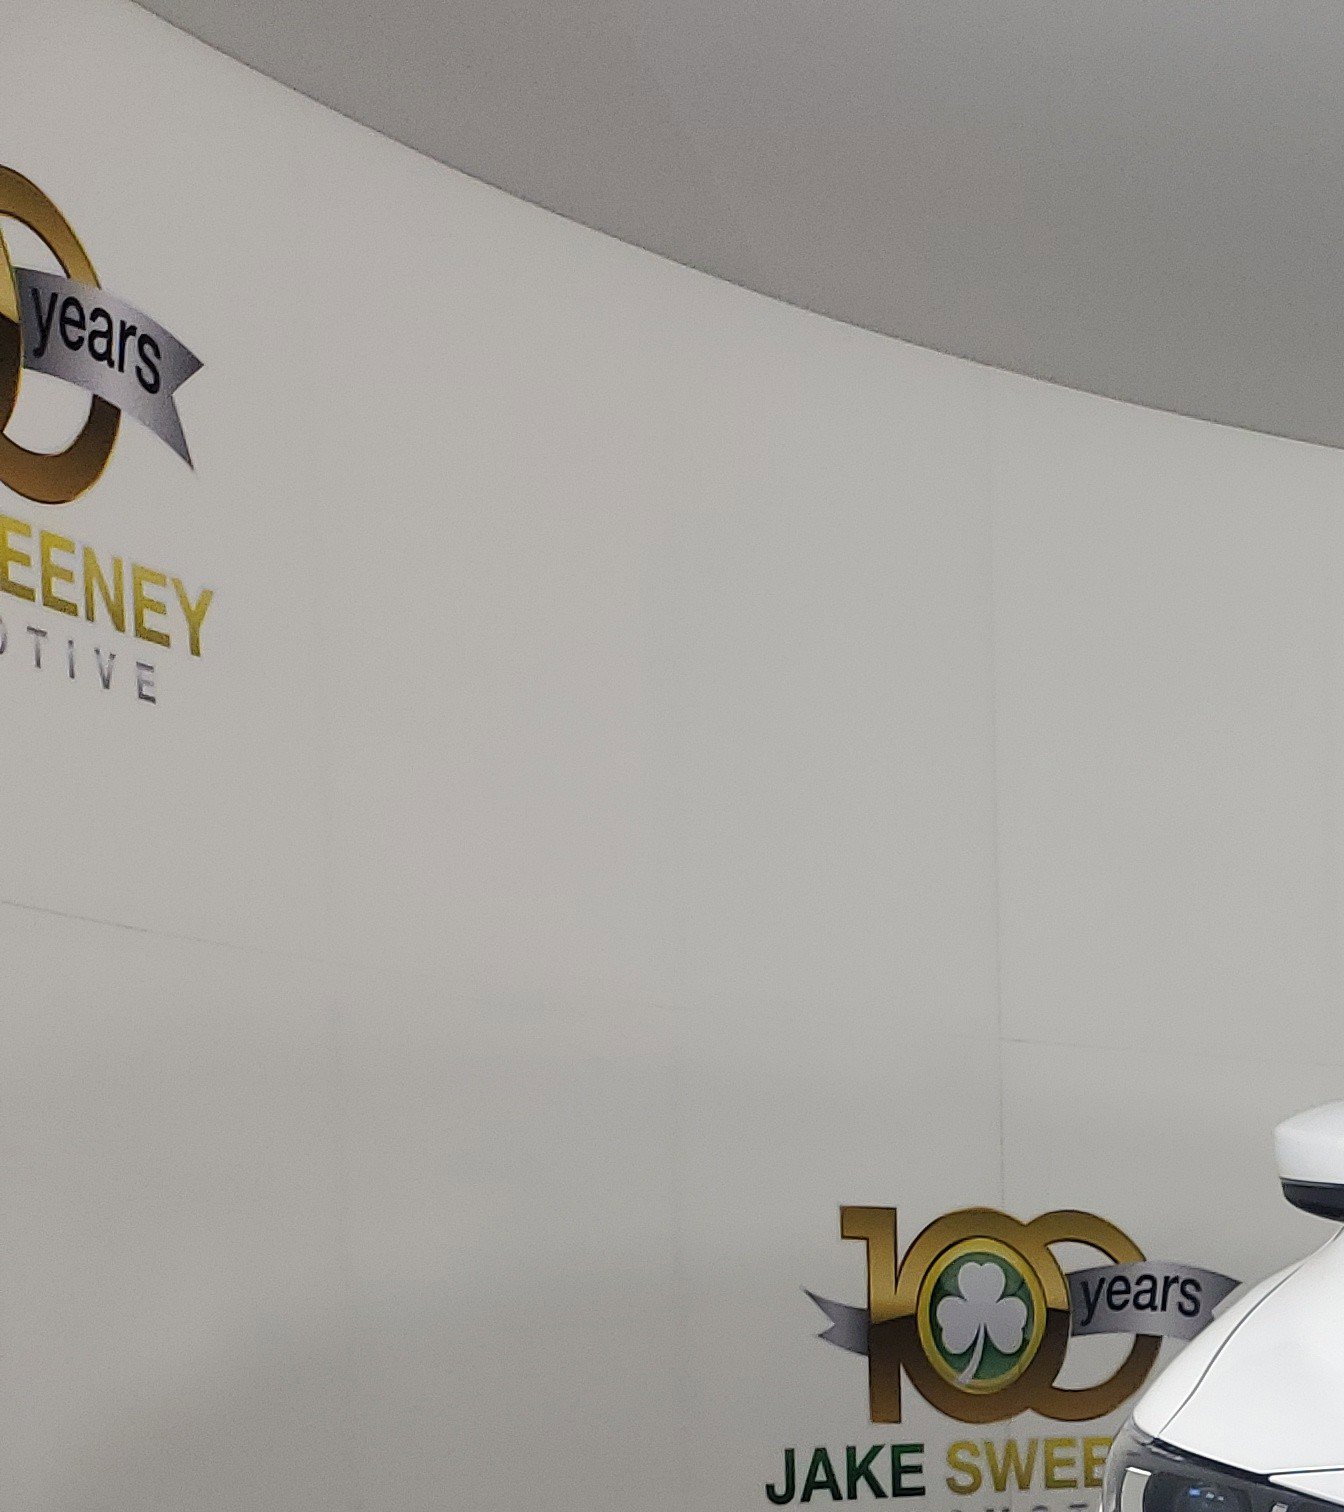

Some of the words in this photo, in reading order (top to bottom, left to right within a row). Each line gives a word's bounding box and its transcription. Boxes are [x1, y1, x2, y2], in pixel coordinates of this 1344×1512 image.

[29, 284, 162, 395] years
[839, 1205, 1163, 1425] 100
[1079, 1272, 1202, 1327] years
[765, 1443, 926, 1506] JAKE
